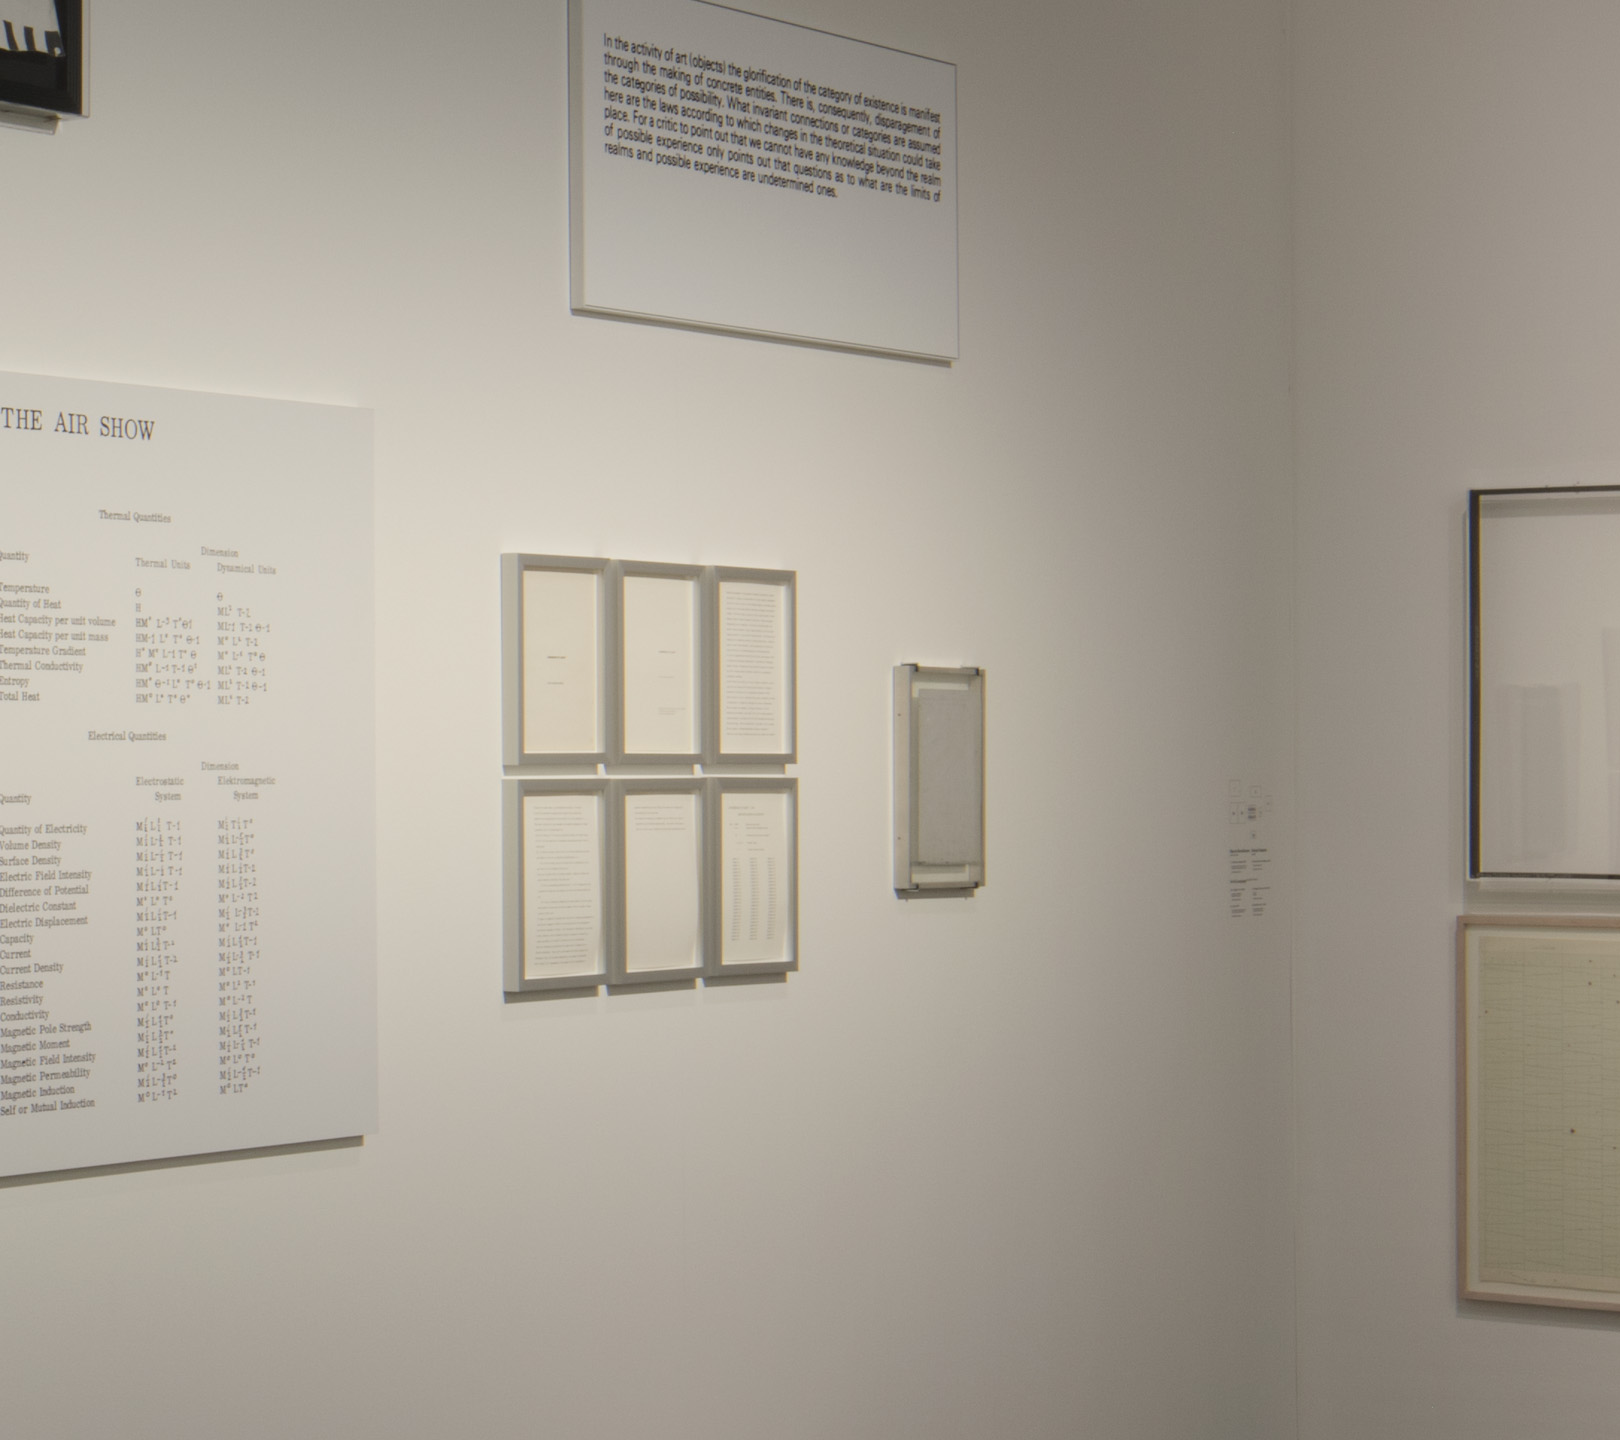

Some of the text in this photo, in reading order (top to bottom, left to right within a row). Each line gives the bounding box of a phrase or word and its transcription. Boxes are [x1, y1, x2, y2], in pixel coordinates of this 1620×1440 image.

[604, 33, 941, 124] In the activity of art (objects) the glorification of the category of existence is manifest
[604, 52, 941, 140] through the making of concrete entities. There is, consequently, disparagement of
[604, 142, 837, 198] realms and possible experience are undetermined ones.
[0, 407, 42, 431] THE
[54, 412, 89, 435] AIR
[100, 416, 155, 441] SHOW
[99, 510, 171, 523] Thermal Quantities
[33, 599, 40, 609] of
[43, 600, 62, 609] Heat
[20, 615, 52, 627] Capacity
[55, 618, 68, 628] per
[70, 616, 86, 626] unit
[88, 616, 116, 626] volume
[52, 646, 86, 656] Gradient
[35, 661, 83, 673] Conductivity
[22, 692, 40, 701] Heat
[88, 731, 166, 742] Electrical Quantities
[34, 824, 42, 834] of
[44, 824, 87, 836] Electricity
[0, 840, 61, 851] Volume Density
[0, 1098, 95, 1116] Self or Mutual Induction
